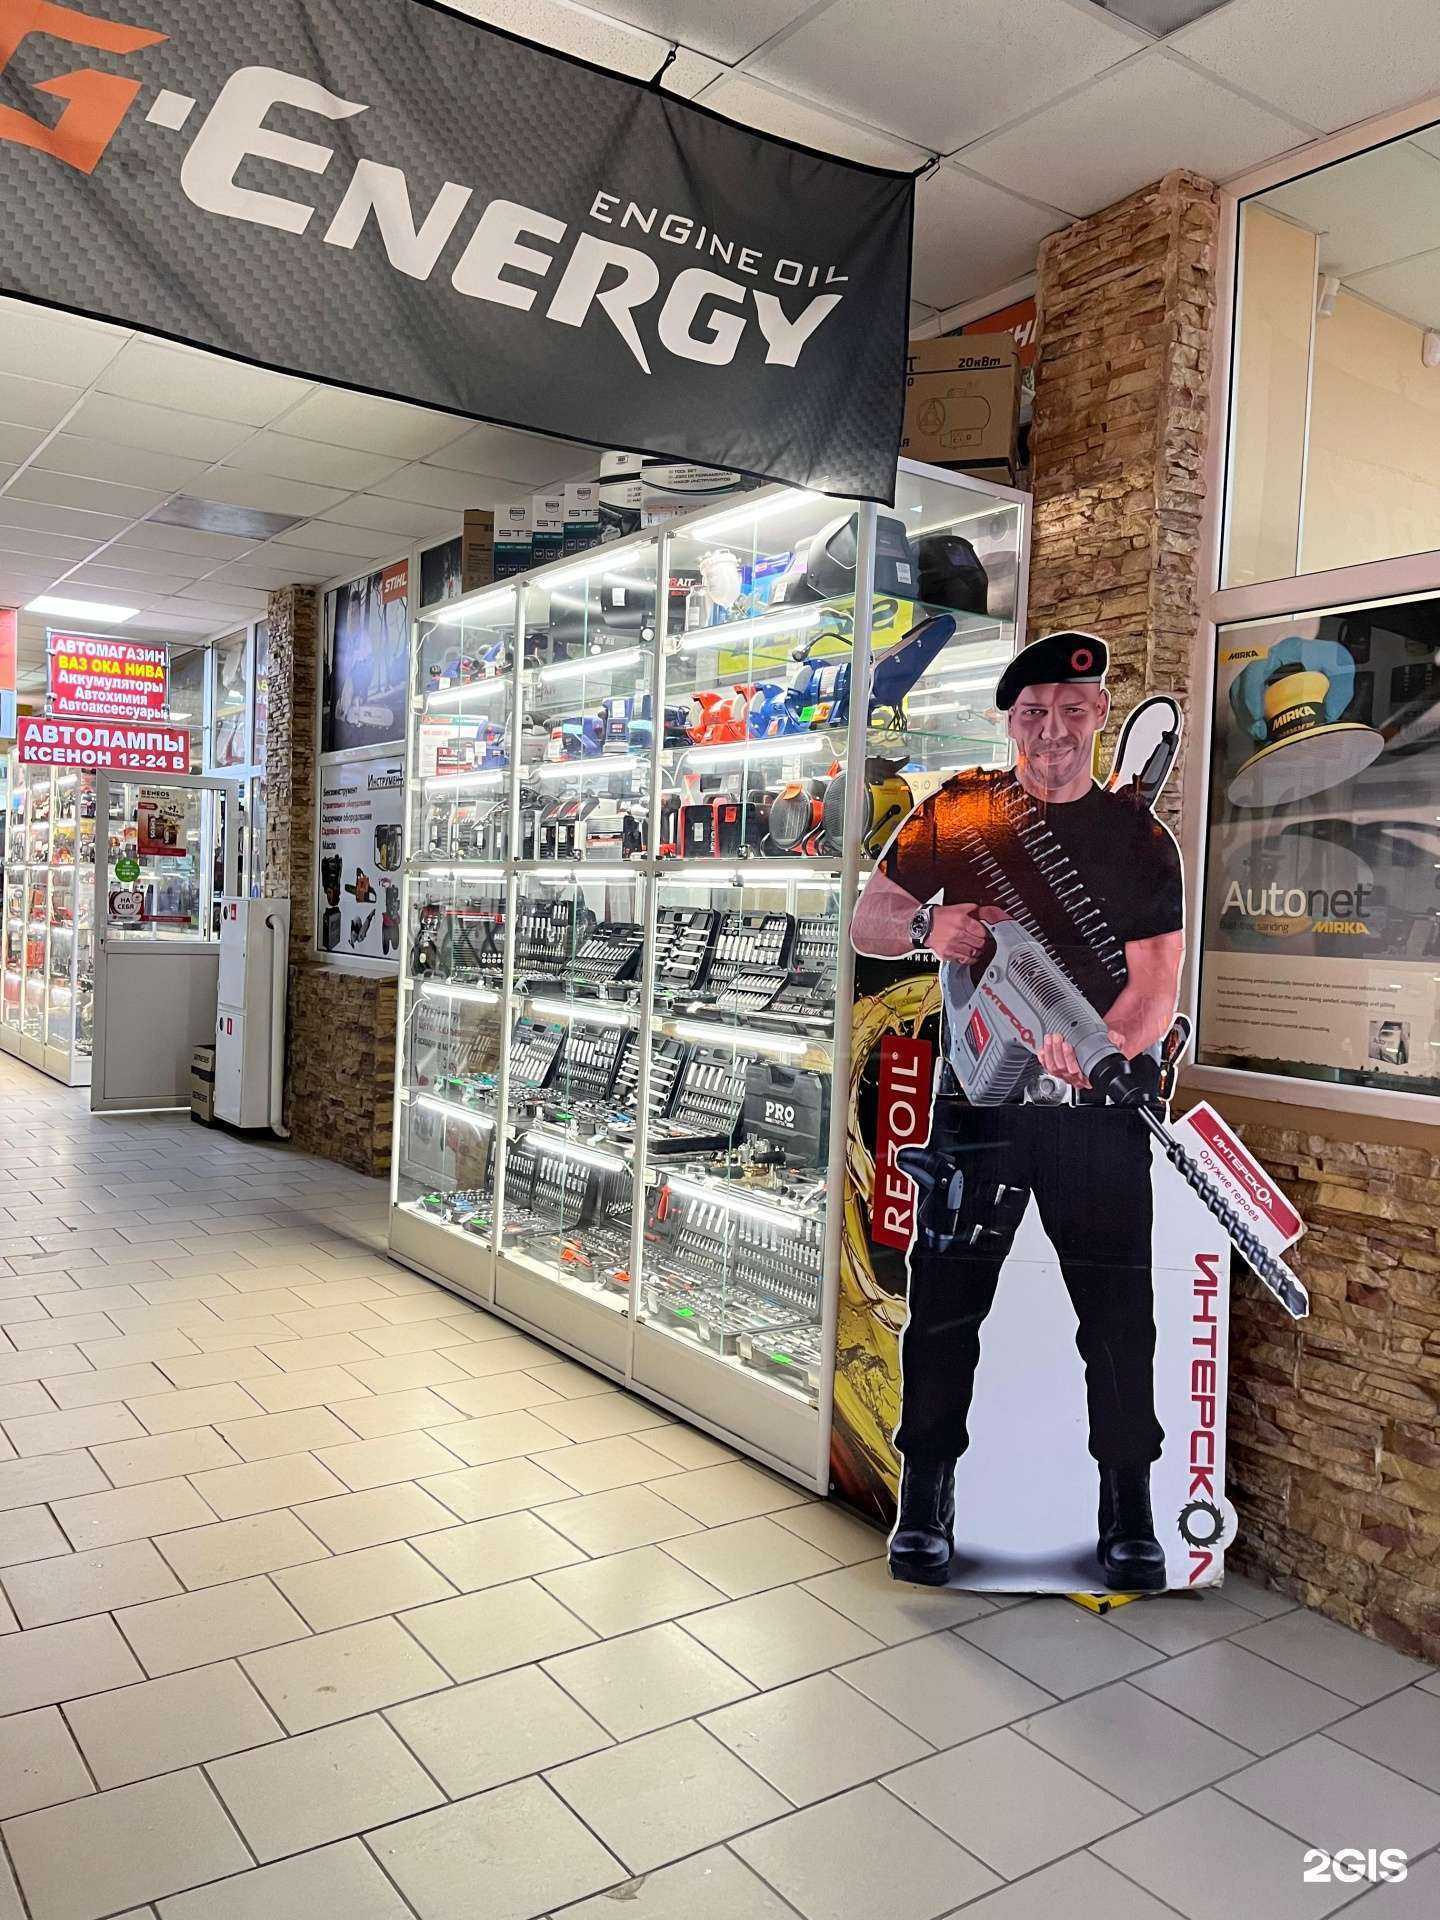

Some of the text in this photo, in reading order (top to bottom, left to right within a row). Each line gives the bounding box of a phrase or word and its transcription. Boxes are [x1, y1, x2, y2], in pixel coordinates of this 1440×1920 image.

[590, 190, 850, 289] ENGINE OIL
[384, 572, 407, 593] STIHL
[56, 639, 165, 664] АВТОМАГАЗИН
[1227, 650, 1260, 661] MIRKA
[58, 655, 164, 679] ВАЗ ОКА НИВА
[58, 670, 164, 694] Аккумуляторы
[75, 686, 149, 705] Автохимия
[59, 697, 167, 720] Автоаксессуары
[1272, 705, 1317, 732] MIRKA
[24, 724, 184, 753] АВТОЛАМПЫ
[24, 745, 185, 770] КСЕНОН 12-24 В
[1221, 880, 1371, 919] Autonet
[1311, 920, 1371, 936] MIRKA
[765, 1100, 796, 1123] PRO
[1213, 1134, 1273, 1210] ИНТЕРСКОЛ
[1200, 1150, 1251, 1222] Оружие героев
[1178, 1253, 1228, 1586] ИНТЕРСКОЛ
